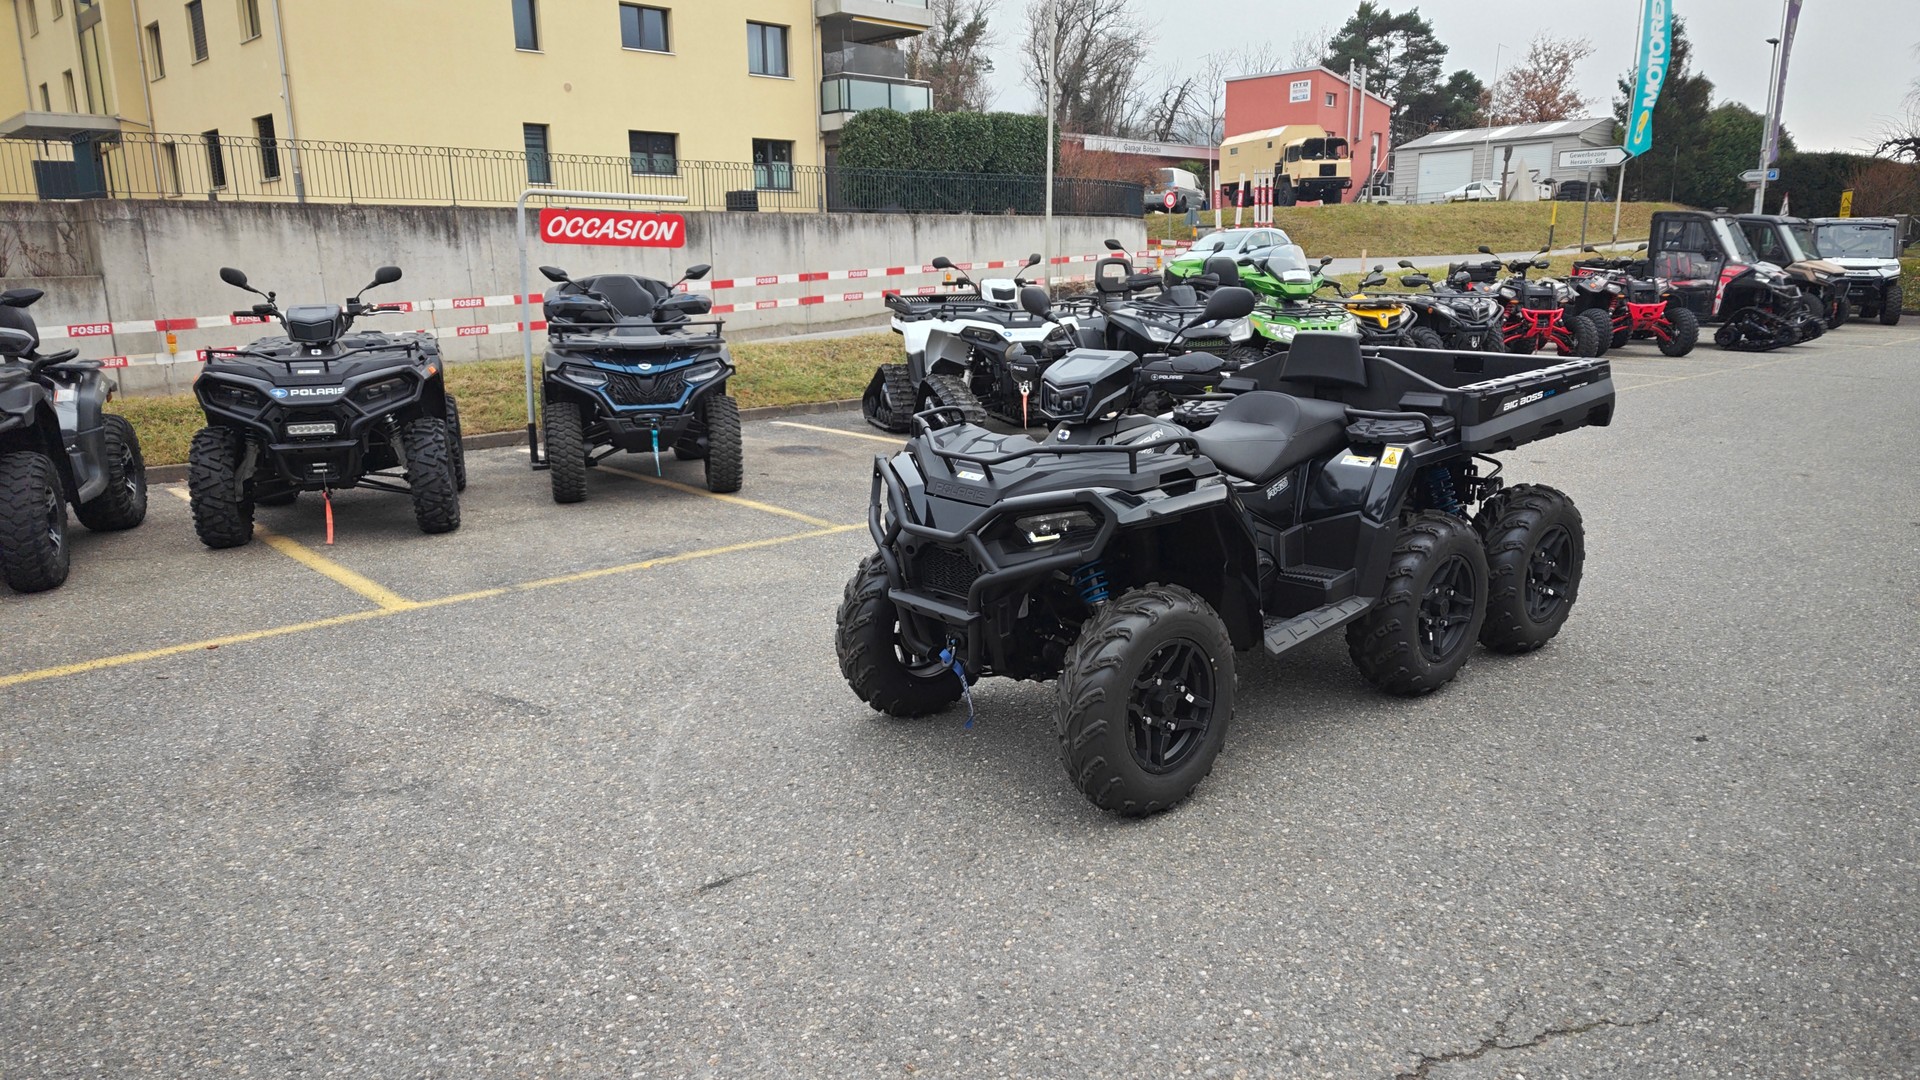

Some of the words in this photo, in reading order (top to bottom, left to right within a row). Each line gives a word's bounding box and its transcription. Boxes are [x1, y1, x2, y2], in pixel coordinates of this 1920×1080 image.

[1642, 0, 1665, 107] MOTORE
[1569, 151, 1608, 159] Gewerbezone
[546, 215, 678, 241] OCCASION
[849, 270, 868, 278] FOSER
[756, 276, 777, 285] FOSER
[454, 298, 483, 308] FOSER
[70, 324, 111, 335] FOSER
[459, 326, 487, 336] FOSER
[102, 357, 124, 367] SER
[290, 386, 346, 396] POLARIS
[1503, 399, 1519, 411] BIG
[1520, 390, 1544, 406] BOSS
[934, 482, 986, 500] POLARIS
